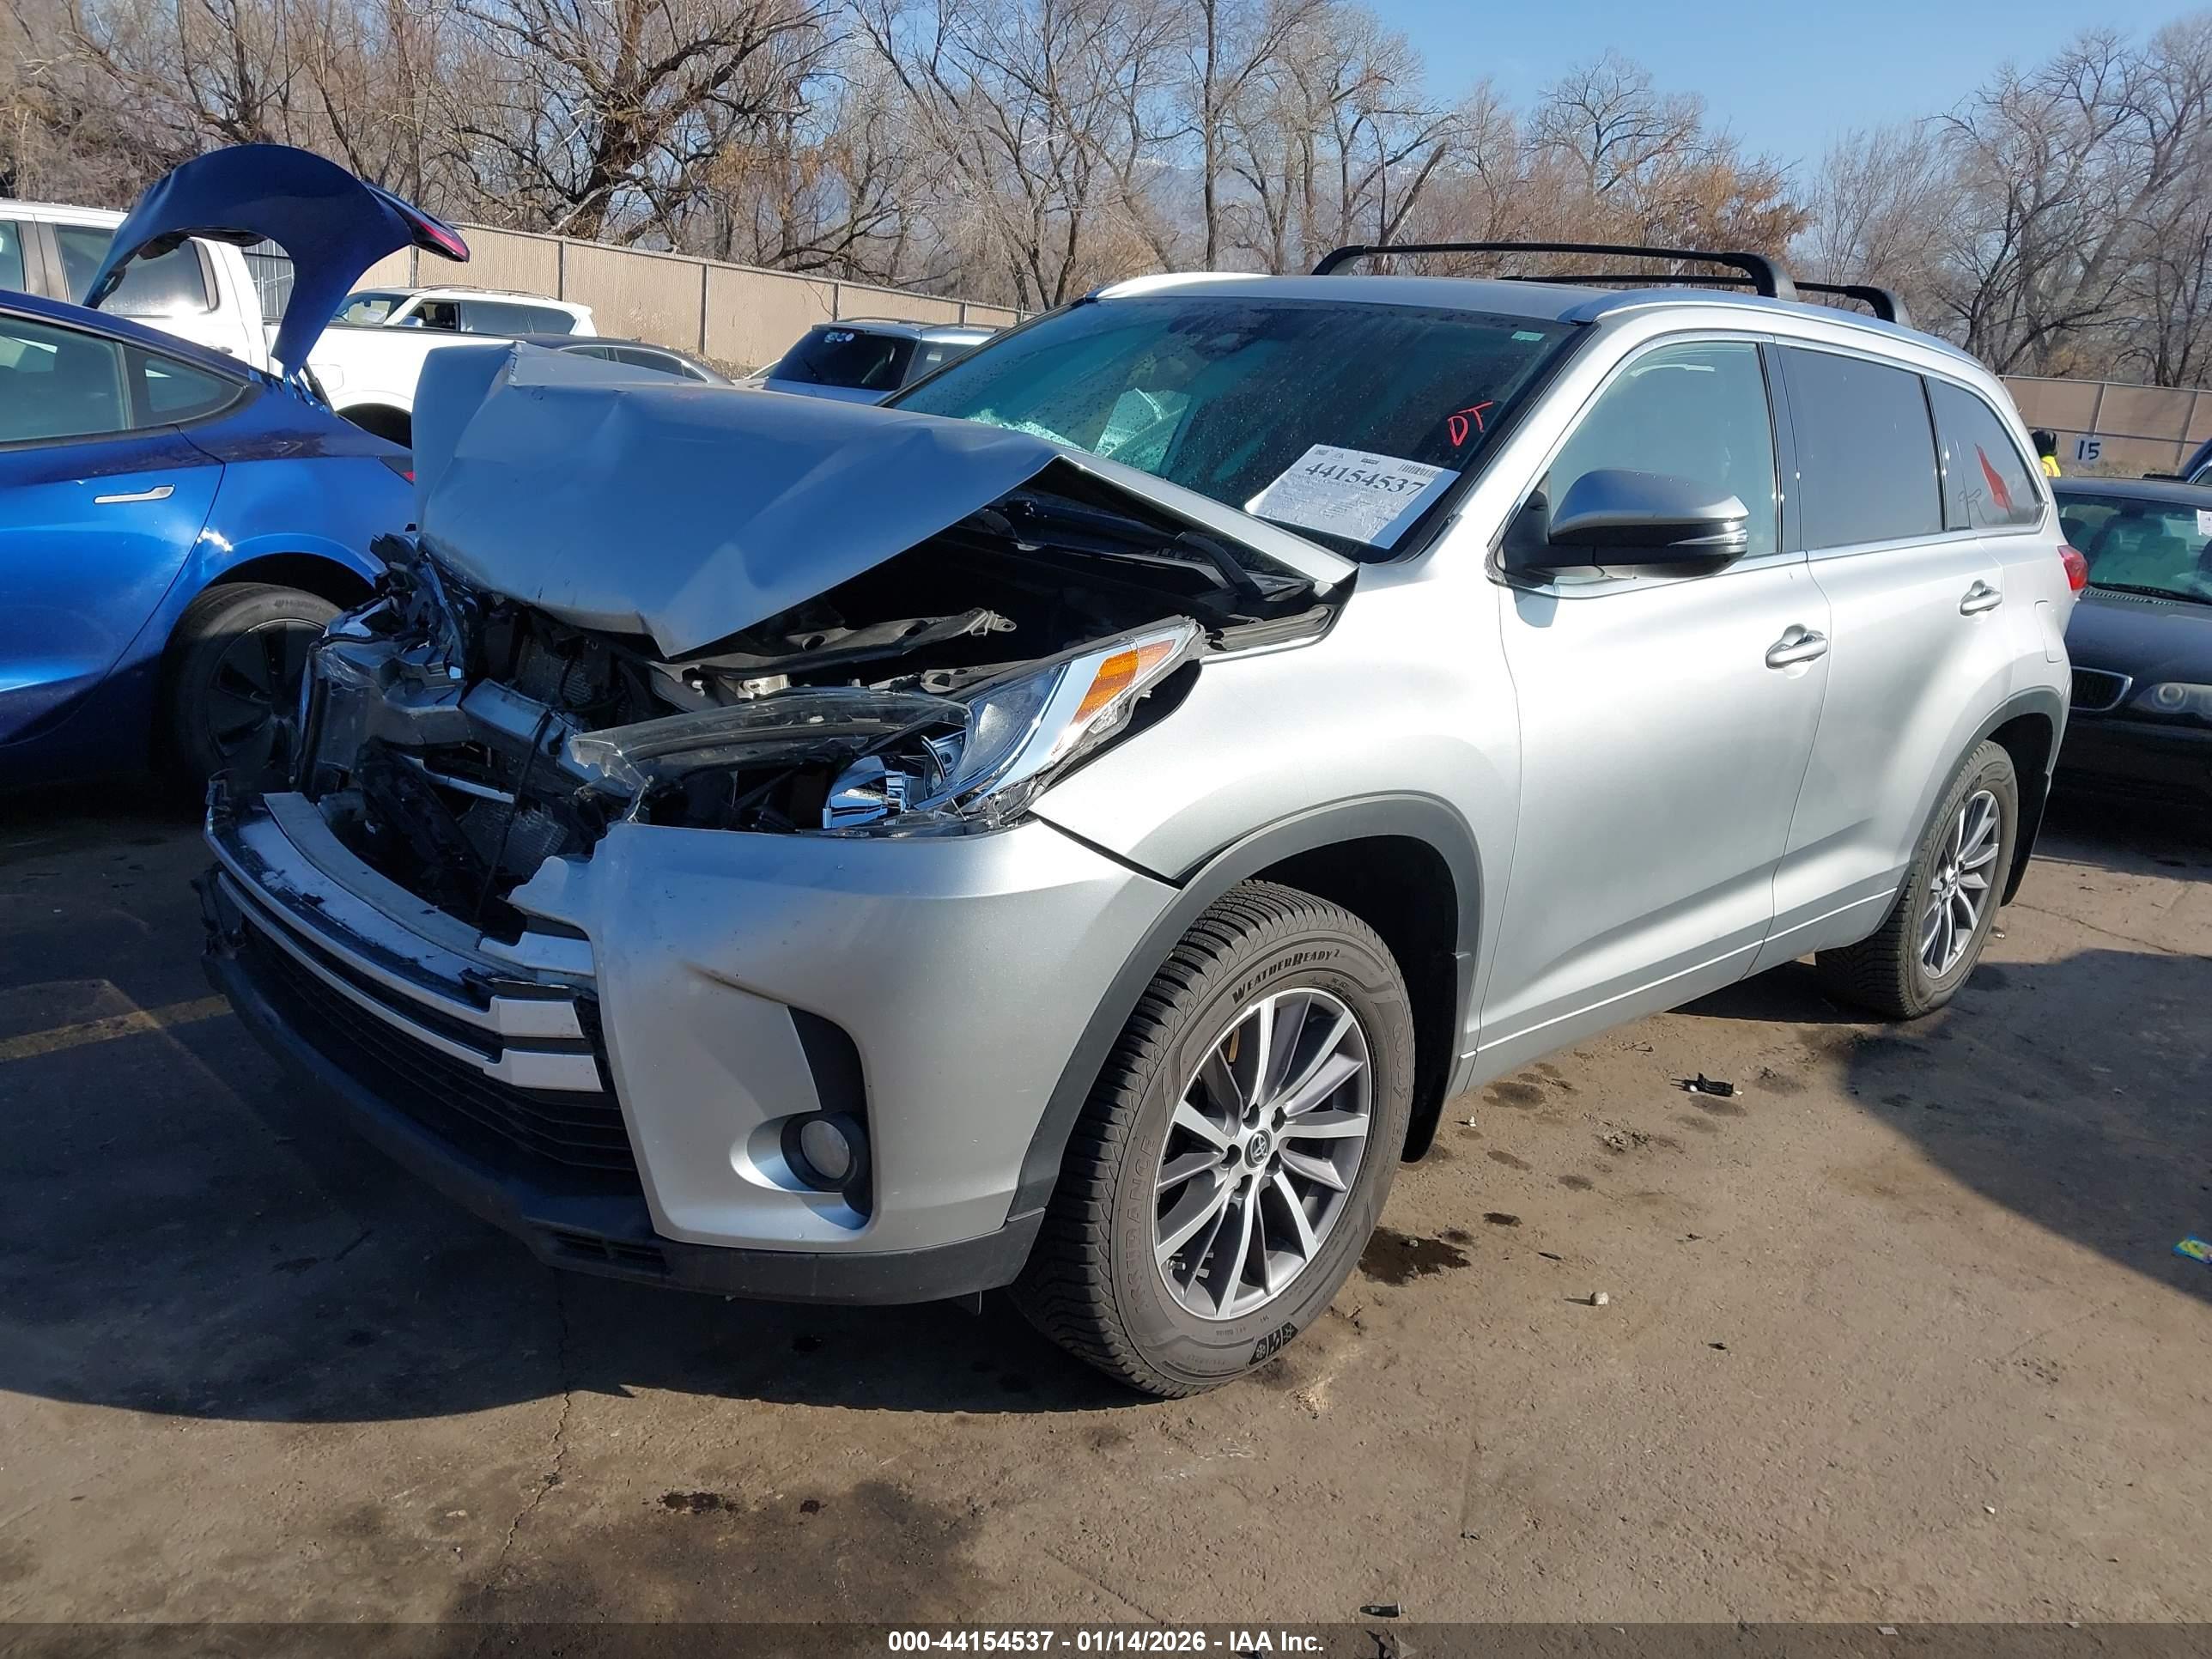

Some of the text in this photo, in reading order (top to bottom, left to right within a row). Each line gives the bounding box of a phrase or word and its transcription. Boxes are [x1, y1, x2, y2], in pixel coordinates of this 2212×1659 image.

[1447, 400, 1494, 447] DT
[2077, 440, 2101, 461] 15
[1304, 462, 1428, 497] 44154537
